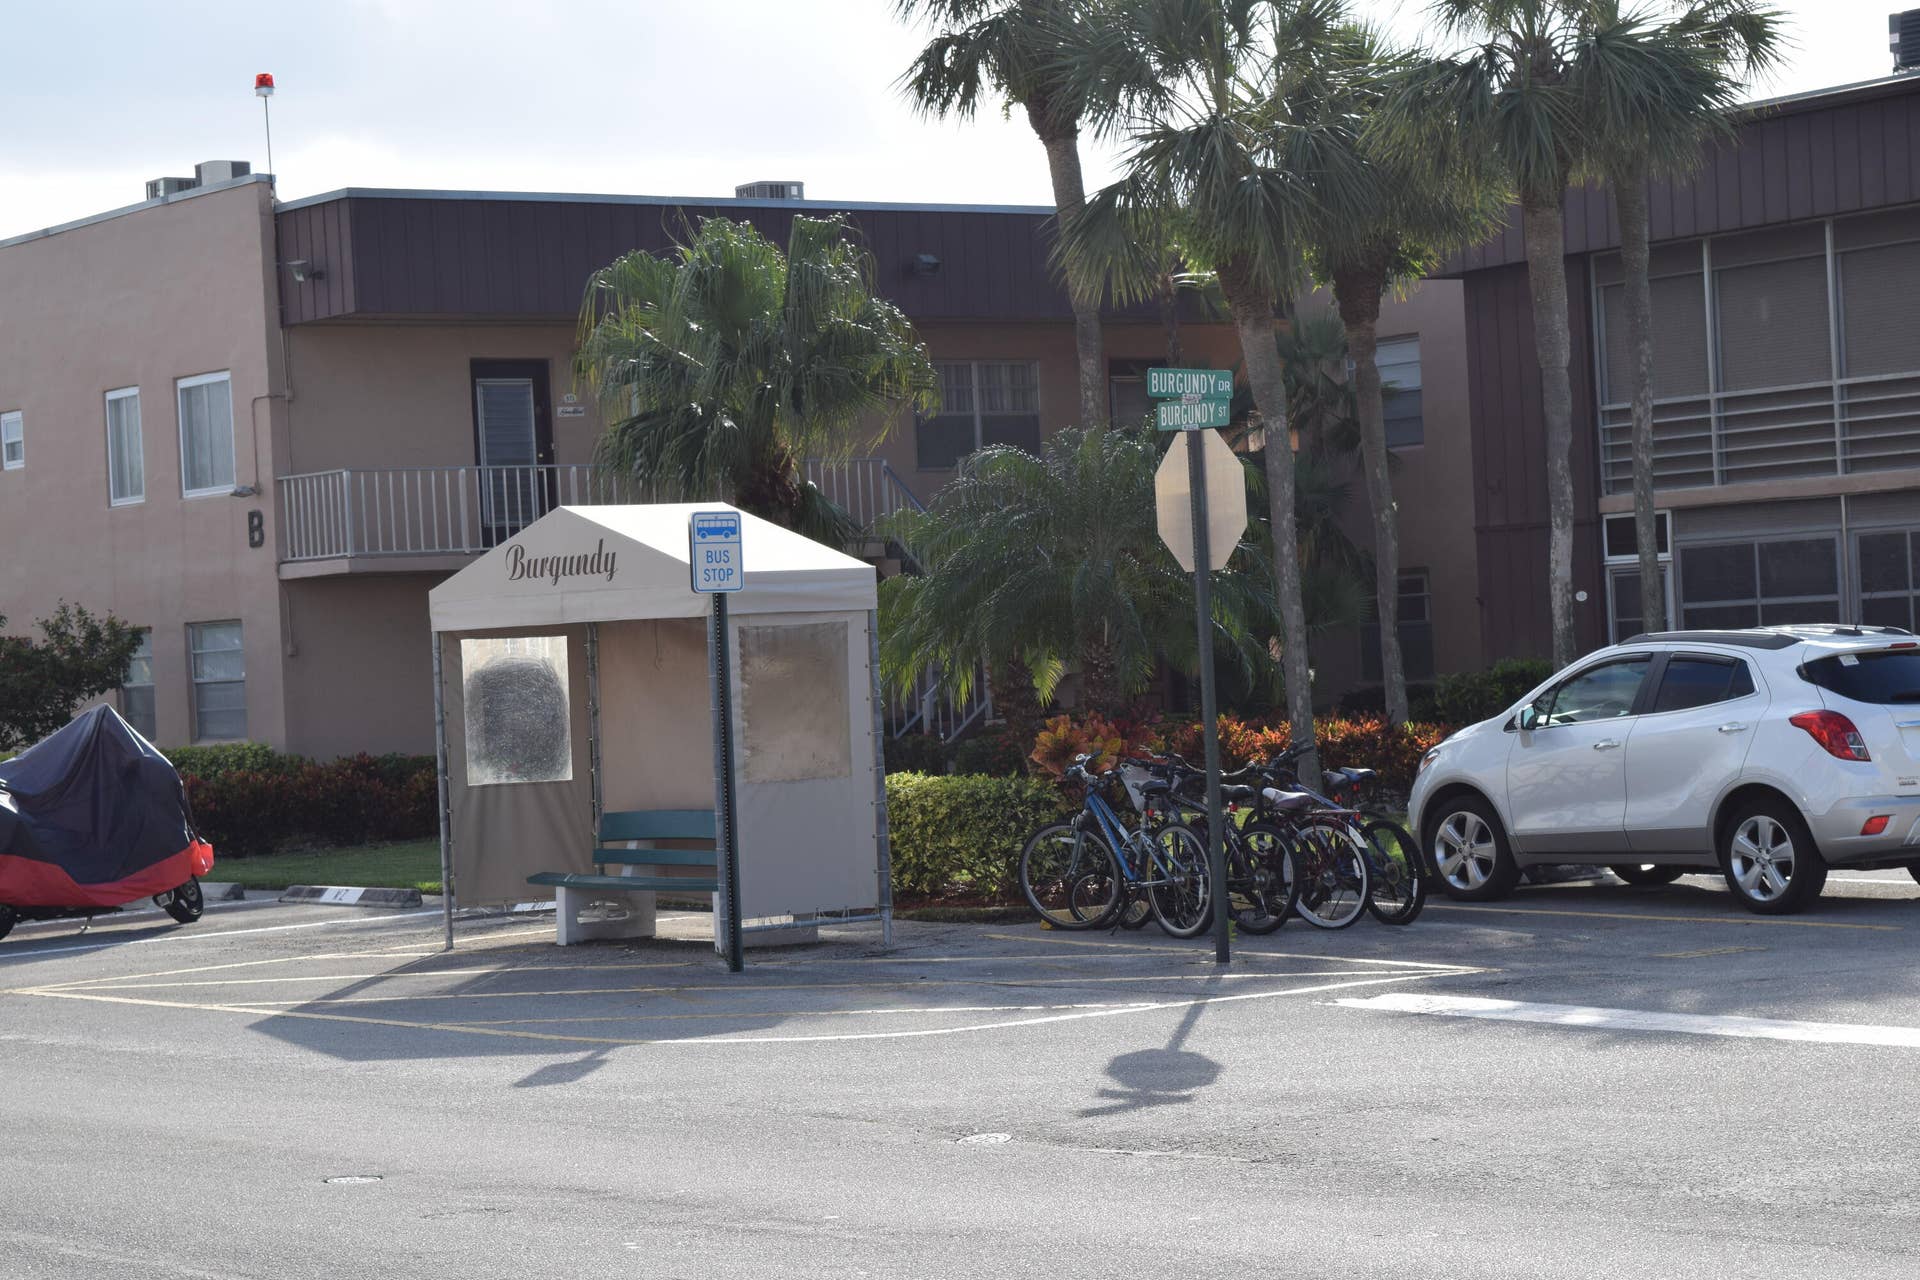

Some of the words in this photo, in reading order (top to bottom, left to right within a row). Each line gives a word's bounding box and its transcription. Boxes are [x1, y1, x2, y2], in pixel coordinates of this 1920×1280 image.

[1151, 372, 1216, 394] BURGUNDY
[1218, 380, 1231, 392] DR
[1161, 403, 1215, 426] BURGUNDY
[1218, 406, 1227, 417] ST
[248, 511, 264, 548] B
[505, 538, 618, 586] Burgundy
[706, 550, 730, 564] BUS
[703, 568, 734, 582] STOP
